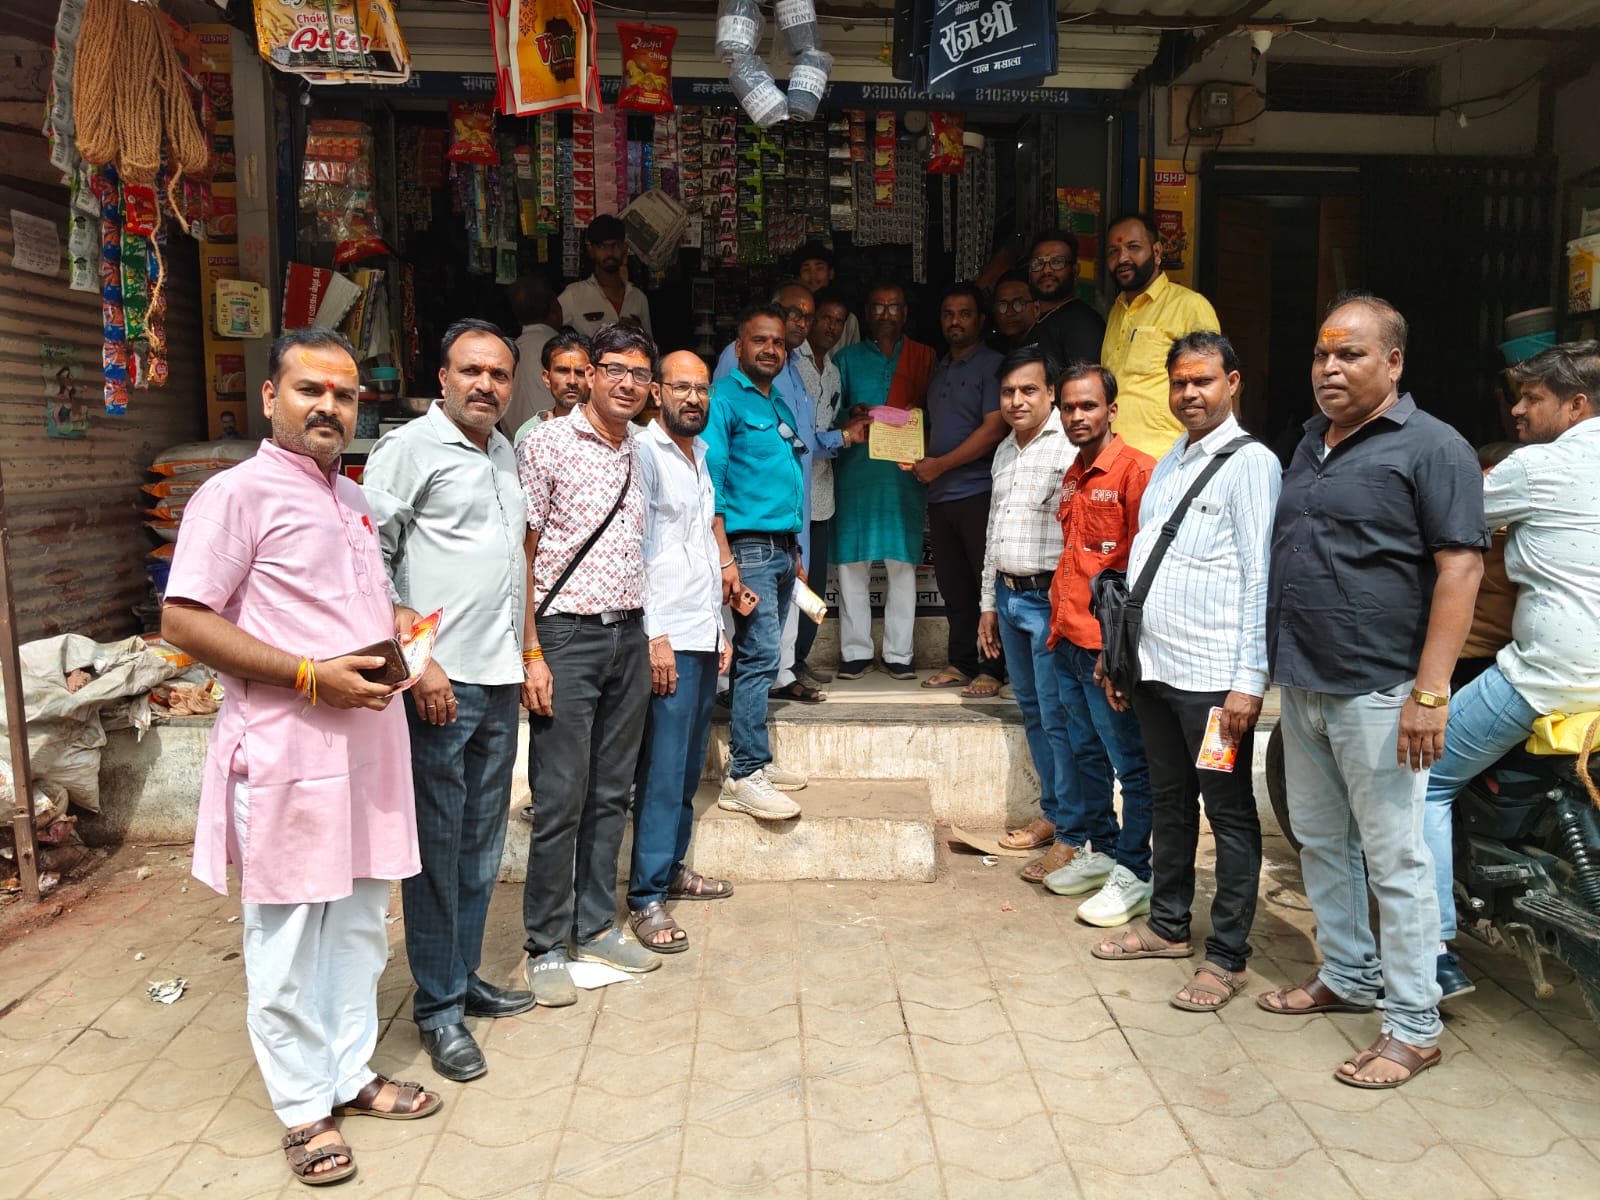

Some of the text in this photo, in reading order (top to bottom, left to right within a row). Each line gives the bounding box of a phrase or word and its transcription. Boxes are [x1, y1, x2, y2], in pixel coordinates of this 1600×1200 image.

[295, 14, 356, 26] Chakk Fres
[291, 27, 371, 52] Atta
[940, 1, 1018, 63] राजश्री
[972, 56, 1022, 75] पान मसाला
[1154, 173, 1186, 183] USHP
